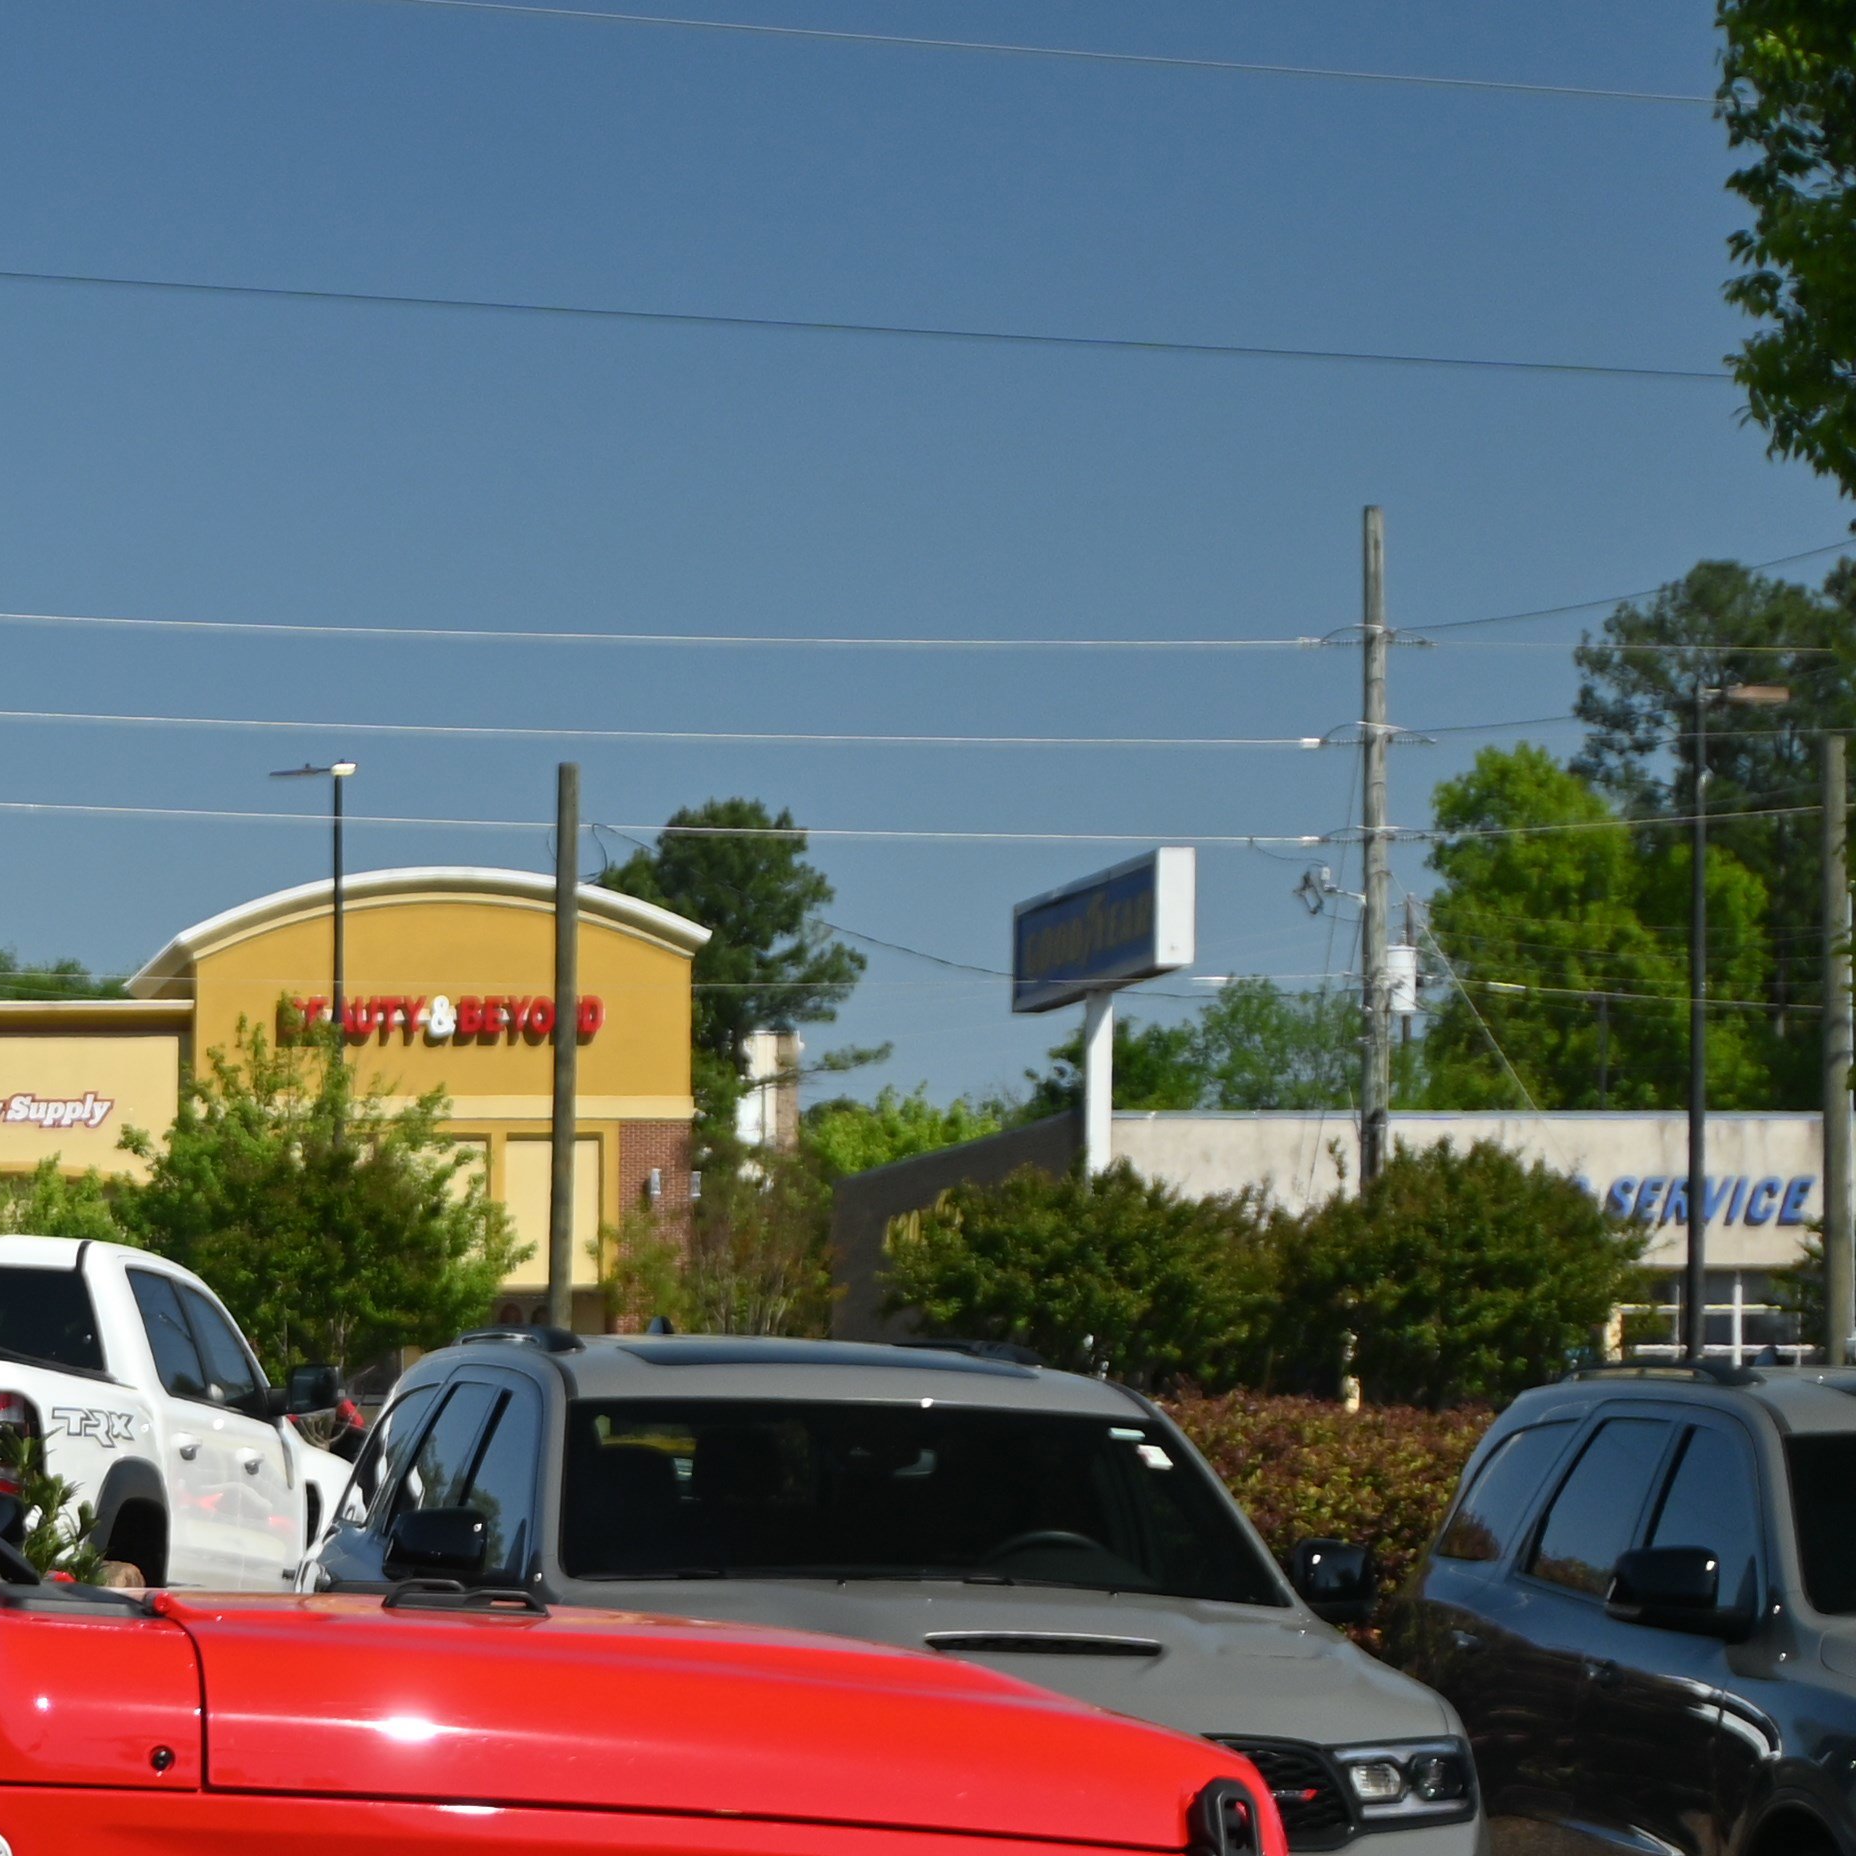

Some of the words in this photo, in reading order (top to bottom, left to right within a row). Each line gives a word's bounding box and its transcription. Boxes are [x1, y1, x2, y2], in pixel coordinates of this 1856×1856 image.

[427, 994, 456, 1038] &
[459, 995, 605, 1033] BEYOD
[5, 1093, 112, 1128] Supply
[51, 1406, 135, 1448] TRX
